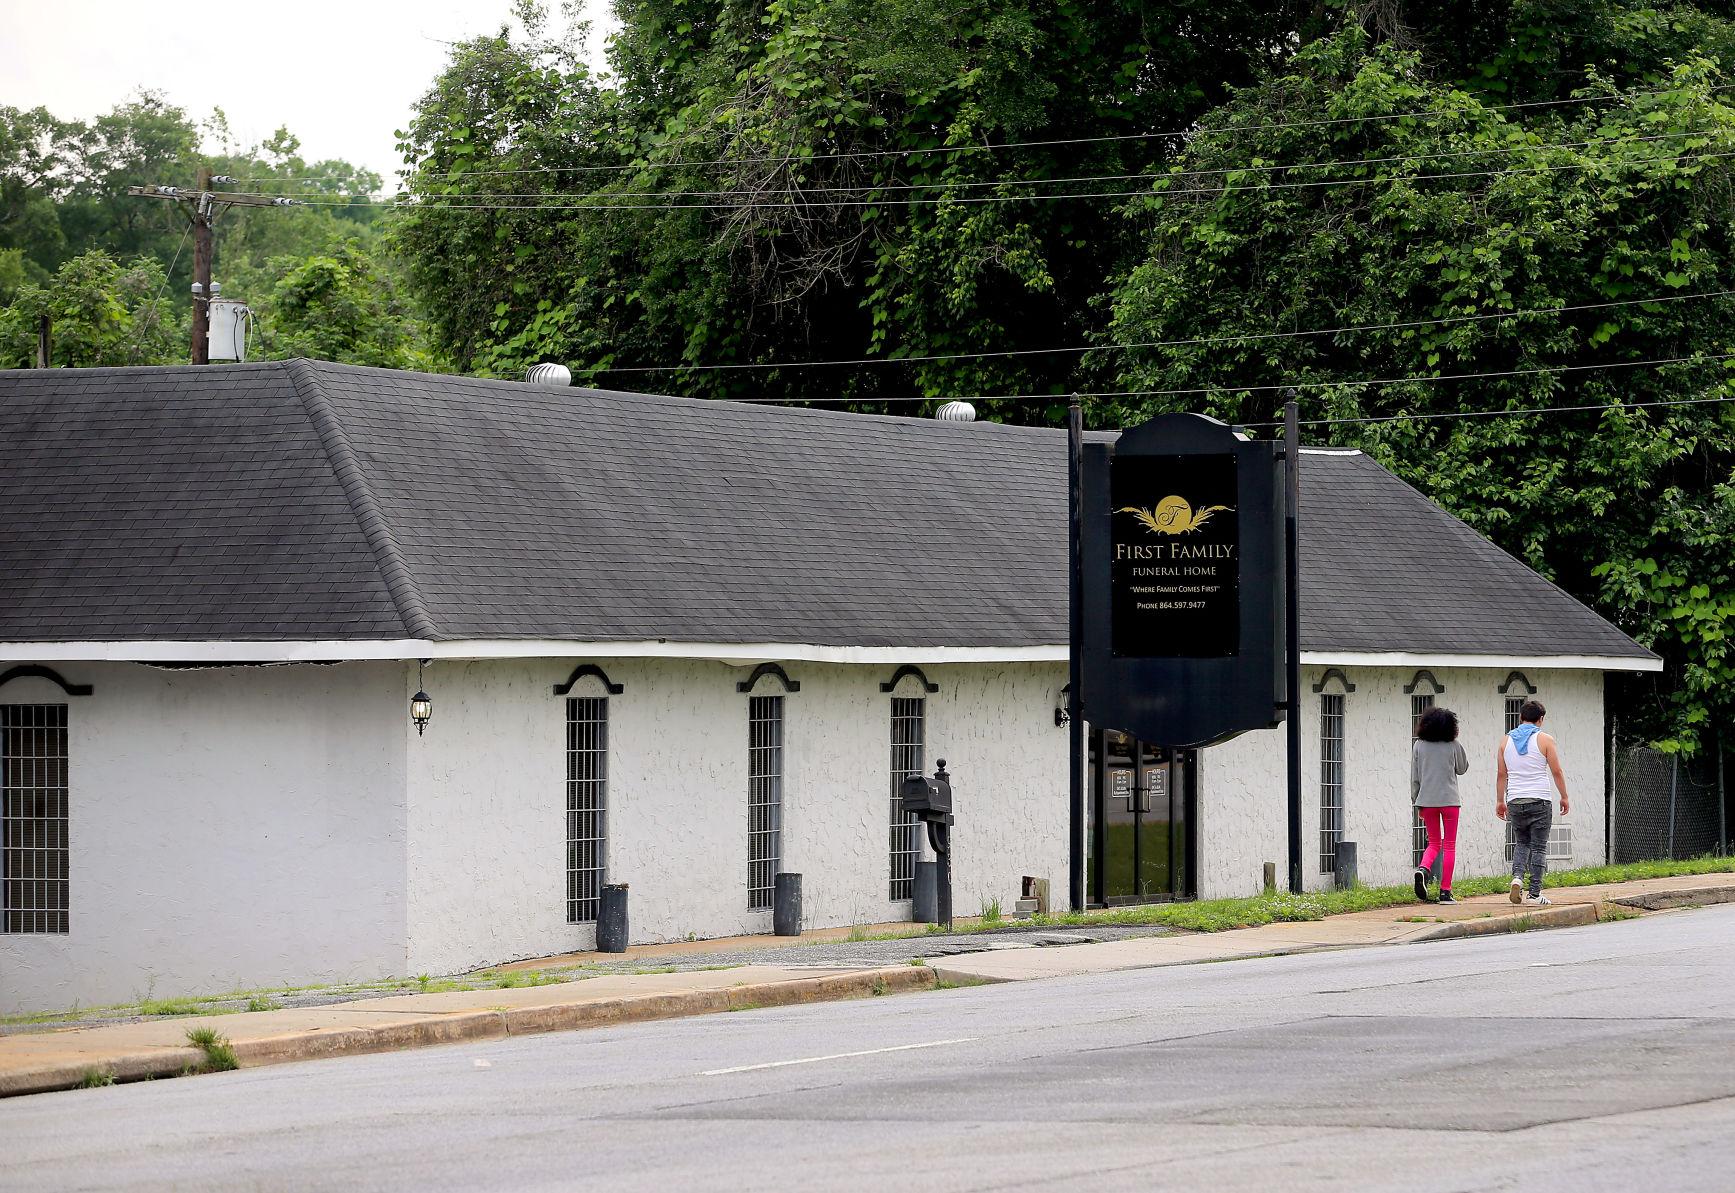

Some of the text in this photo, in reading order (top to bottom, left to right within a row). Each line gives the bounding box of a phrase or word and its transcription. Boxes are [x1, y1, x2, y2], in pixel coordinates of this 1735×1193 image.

[1116, 543, 1234, 559] FIRST FAMILY
[1133, 566, 1216, 576] FUNERAL HOME
[1156, 585, 1178, 593] FAMILY
[1178, 585, 1201, 593] COMES
[1159, 601, 1206, 609] 864.597.9477
